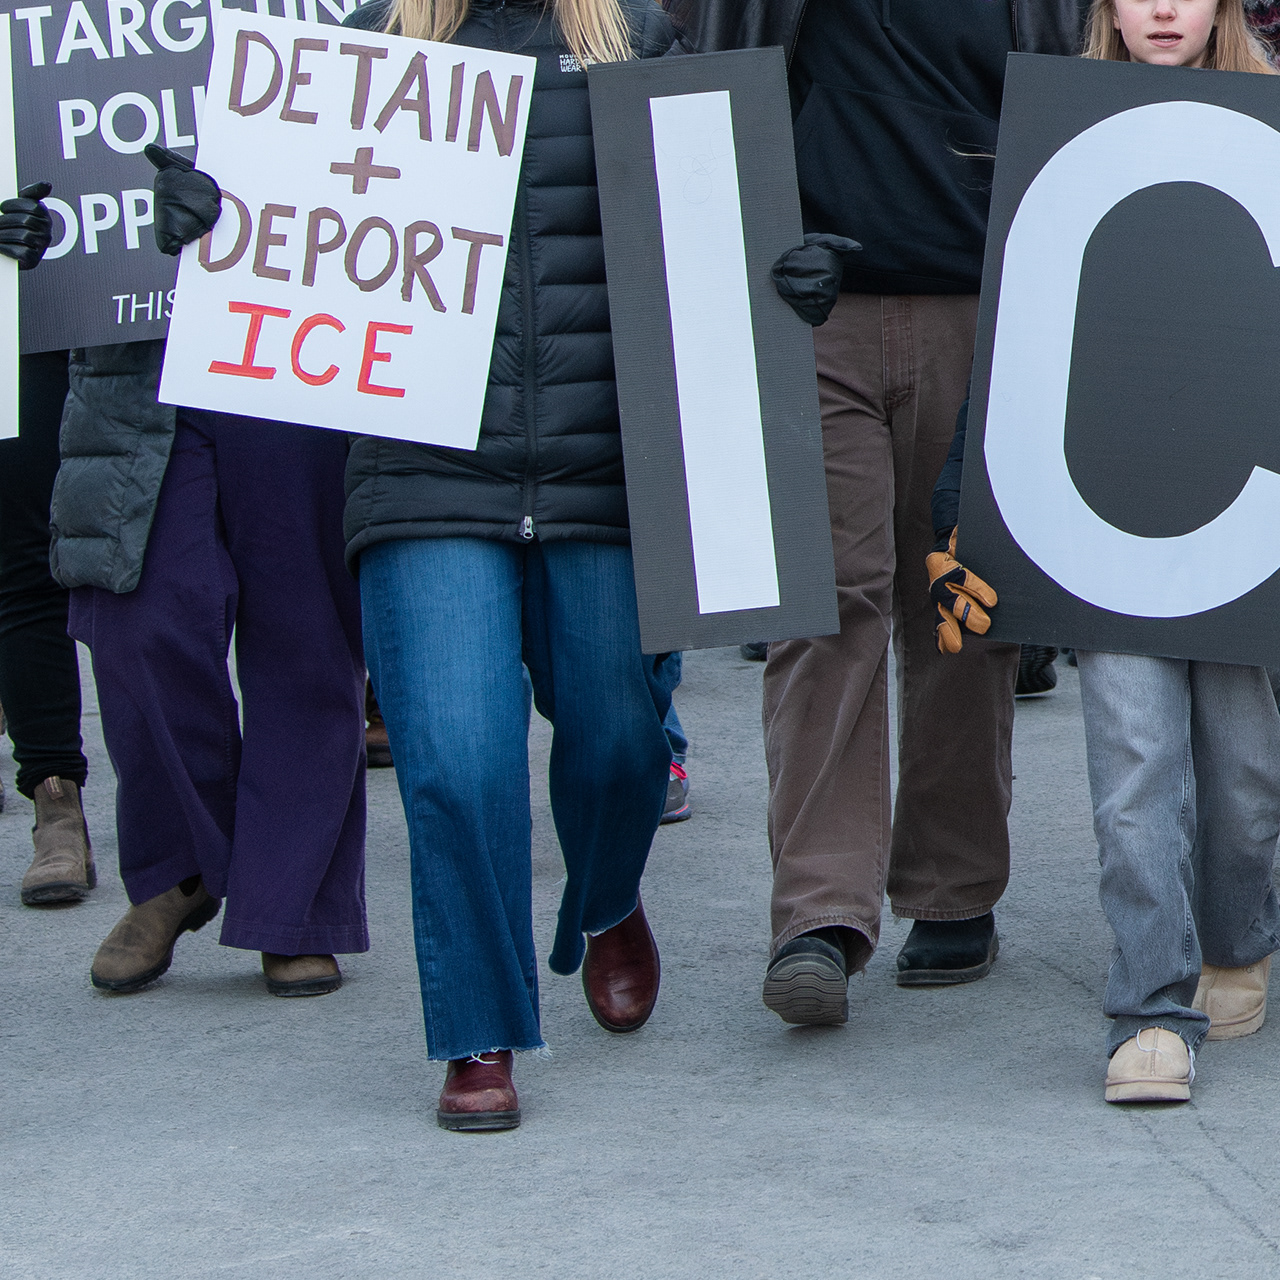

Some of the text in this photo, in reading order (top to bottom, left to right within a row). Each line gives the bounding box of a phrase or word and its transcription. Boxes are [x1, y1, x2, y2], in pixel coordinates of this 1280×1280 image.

[228, 29, 524, 158] DETAIN
[198, 189, 504, 316] DEPORT
[208, 300, 414, 398] ICE
